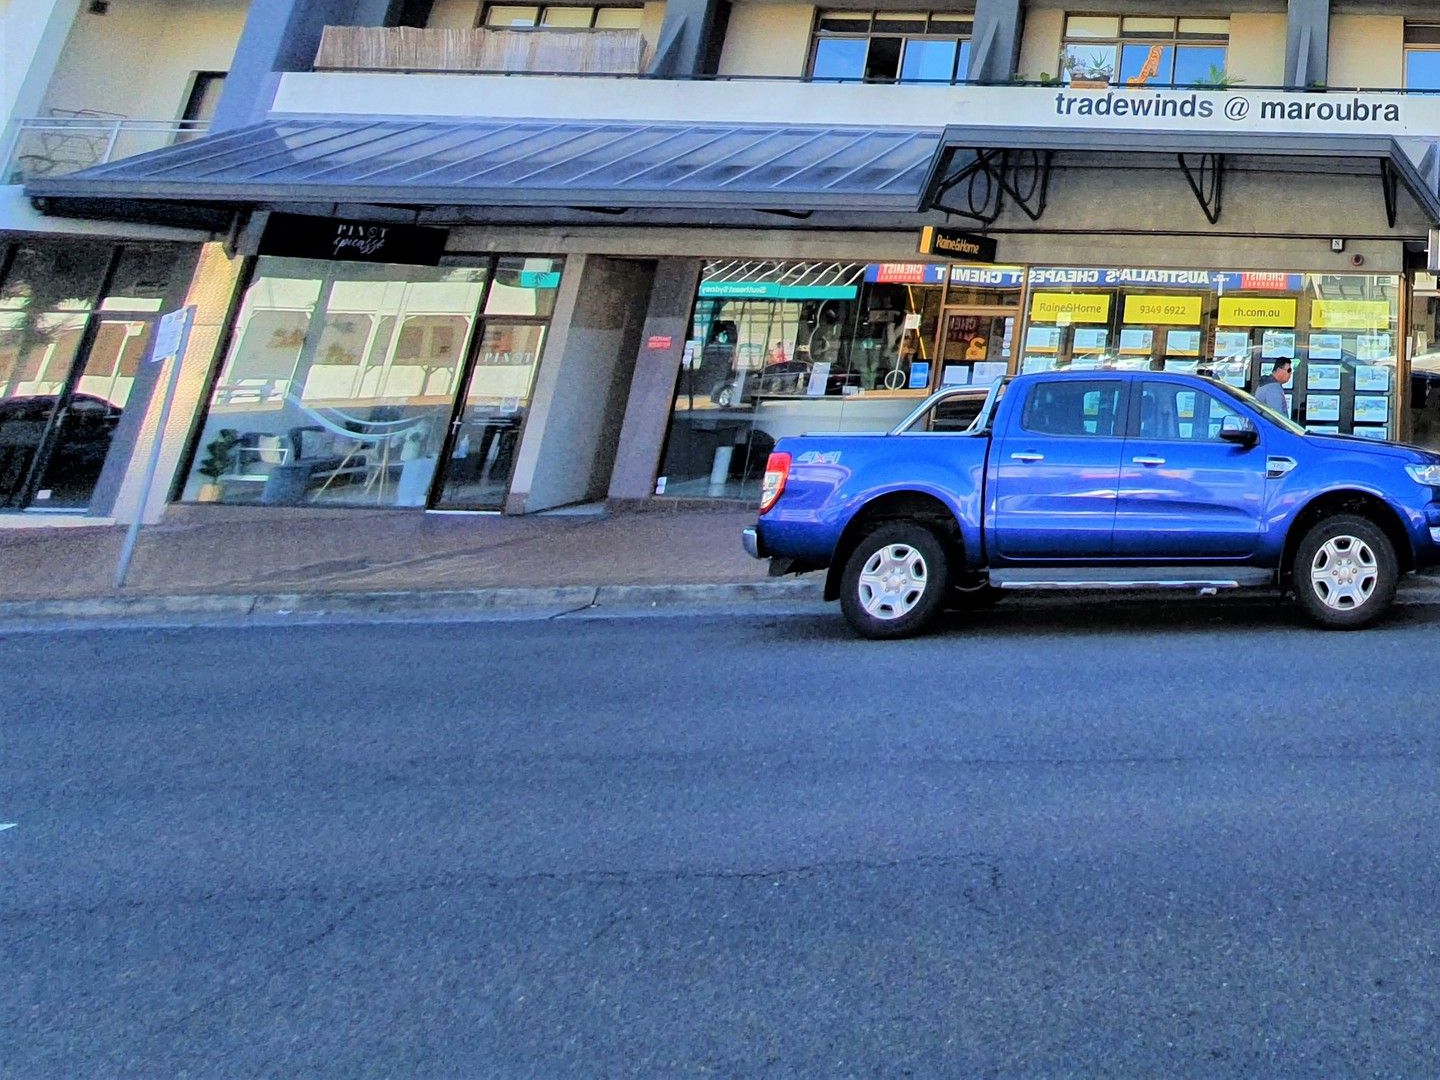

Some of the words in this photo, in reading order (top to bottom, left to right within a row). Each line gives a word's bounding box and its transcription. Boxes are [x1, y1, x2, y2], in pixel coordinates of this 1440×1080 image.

[1055, 93, 1213, 118] tradewinds
[1224, 96, 1249, 120] @
[1260, 98, 1400, 121] maroubra
[1039, 302, 1102, 314] Raine&Horne
[1139, 305, 1162, 315] 9349
[1164, 305, 1186, 315] 6922
[1233, 308, 1280, 318] rh.com.au
